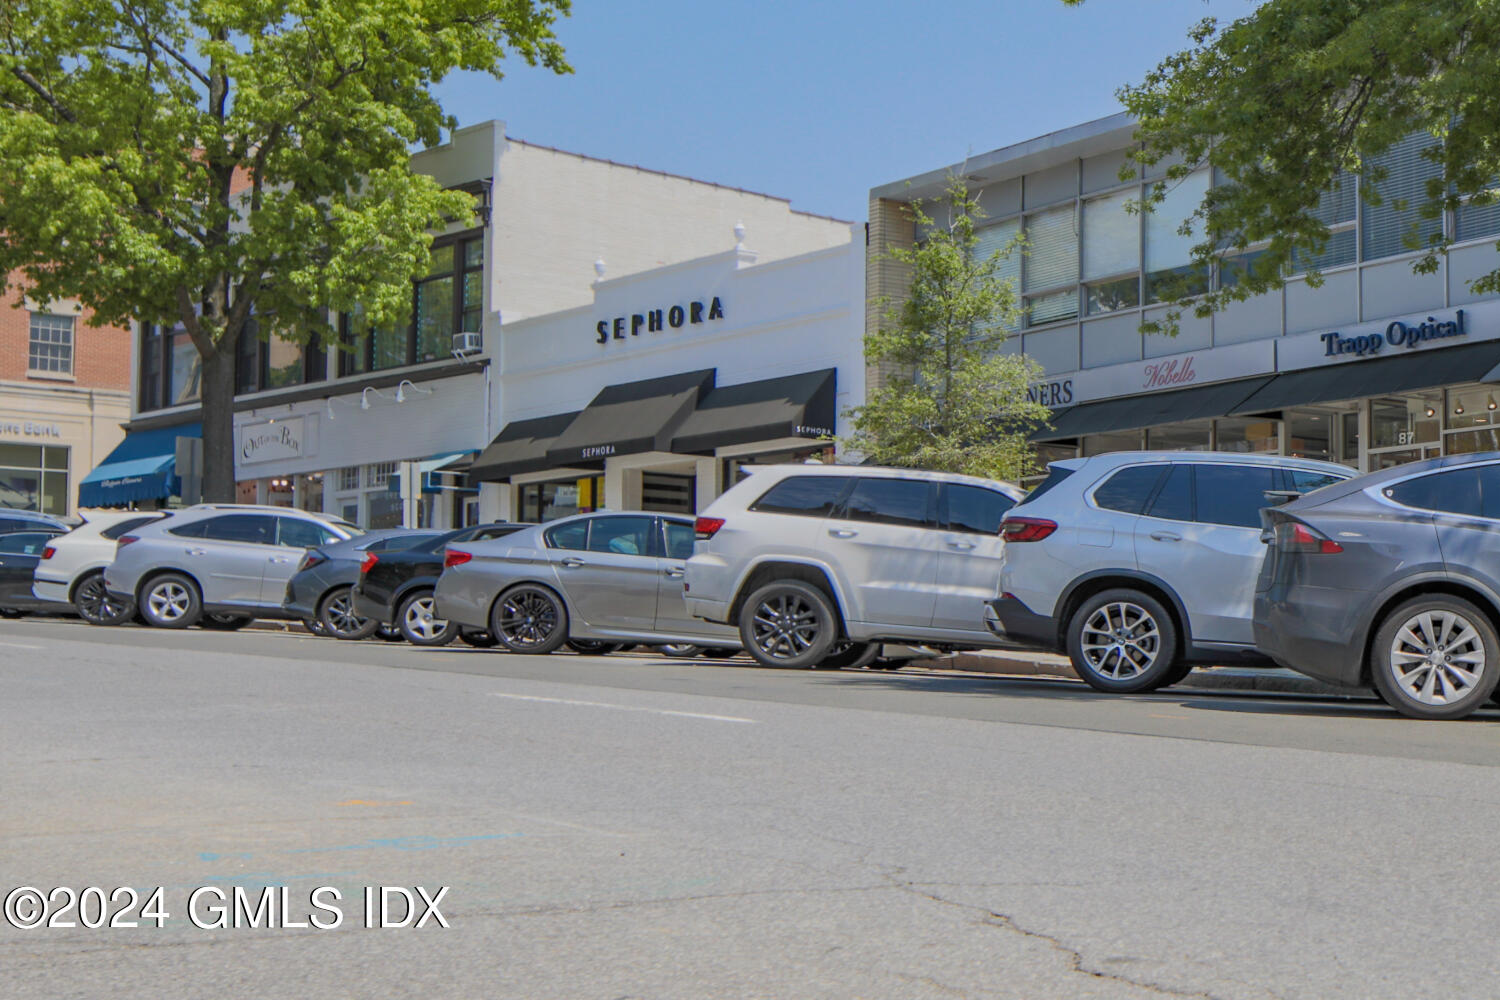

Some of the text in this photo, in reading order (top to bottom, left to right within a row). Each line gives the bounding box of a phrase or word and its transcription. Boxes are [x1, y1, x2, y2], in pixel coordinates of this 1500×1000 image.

[596, 296, 724, 344] SEPHORA
[1320, 309, 1467, 357] Trapp Optical
[795, 425, 832, 435] SEPHORA
[1399, 431, 1414, 445] 87
[582, 445, 616, 459] SEPHORA
